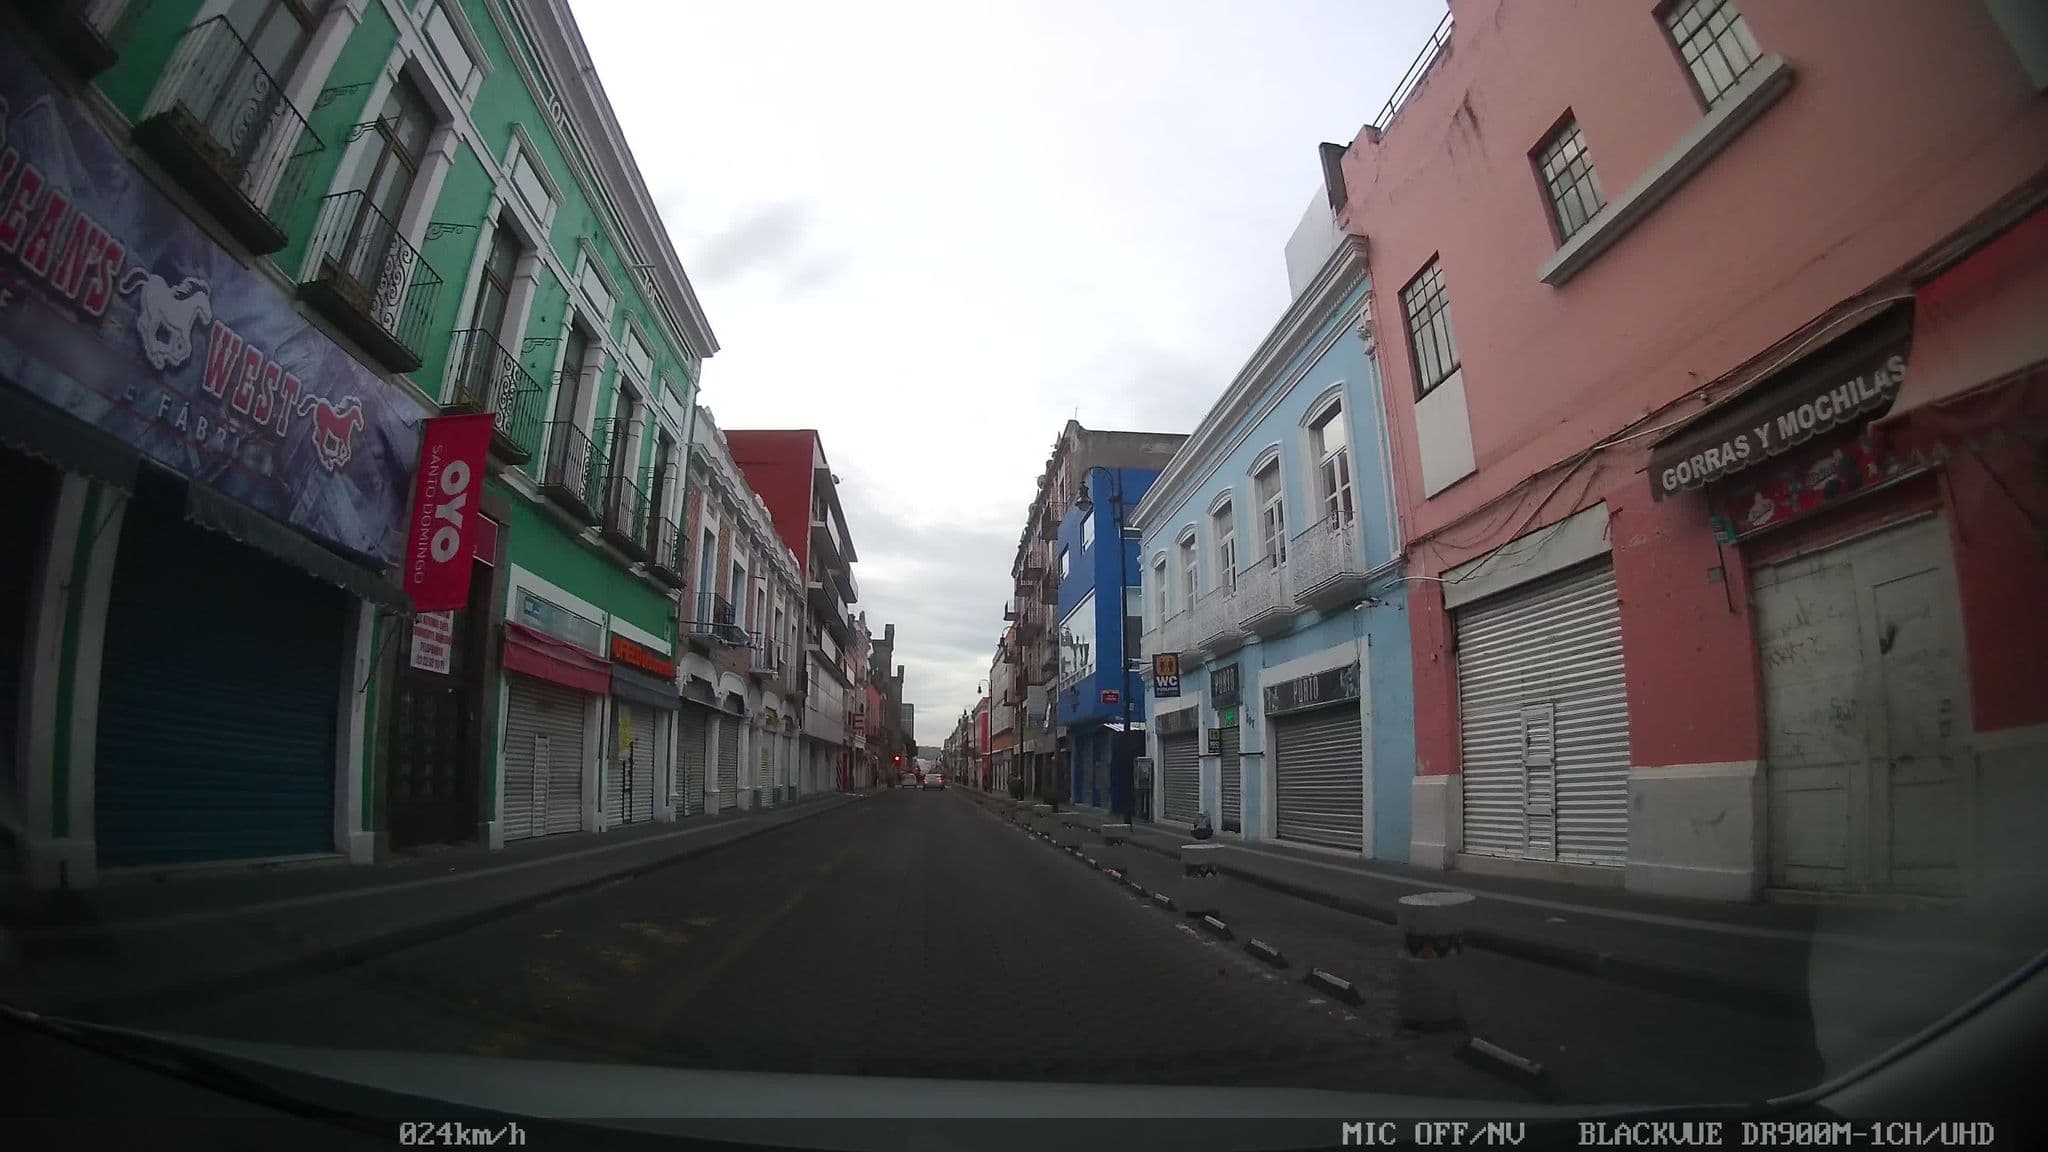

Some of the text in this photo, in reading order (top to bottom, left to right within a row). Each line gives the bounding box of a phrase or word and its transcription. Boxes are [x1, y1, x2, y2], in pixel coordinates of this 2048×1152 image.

[203, 320, 303, 438] WEST
[1662, 434, 1750, 491] GORRAS
[1753, 422, 1772, 449] Y
[1776, 354, 1906, 441] MOCHILAS
[413, 444, 444, 584] SANTO DOMINGO
[430, 459, 471, 563] OYO
[1156, 676, 1178, 687] WC
[1214, 668, 1235, 694] PORTO
[1292, 675, 1319, 704] PORTO
